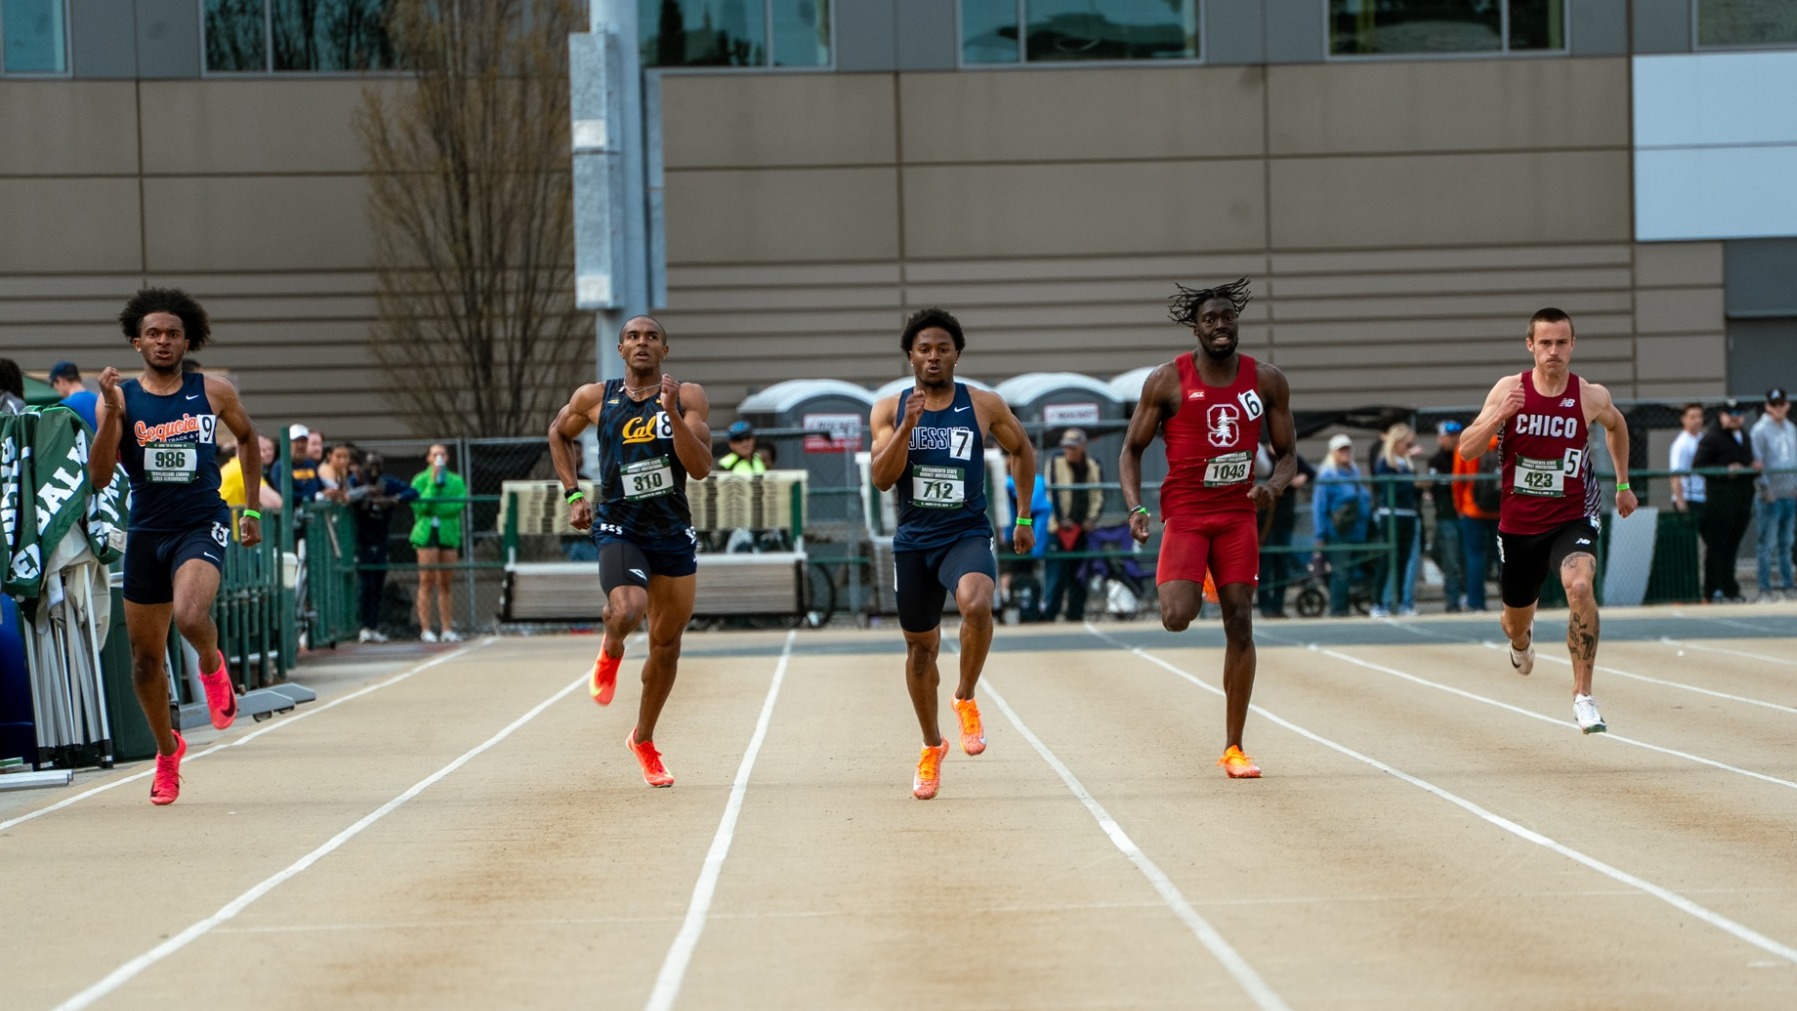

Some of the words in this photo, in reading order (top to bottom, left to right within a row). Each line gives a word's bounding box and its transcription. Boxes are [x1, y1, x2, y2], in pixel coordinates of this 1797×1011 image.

[1244, 392, 1260, 416] 6
[202, 416, 212, 441] 9
[622, 417, 656, 444] Cal
[661, 414, 673, 437] 8
[1515, 413, 1578, 438] CHICO
[908, 426, 969, 450] JESS
[956, 432, 969, 457] 7
[155, 451, 185, 468] 986
[1213, 464, 1246, 479] 1043
[1565, 450, 1579, 475] 5
[633, 472, 662, 491] 310
[923, 481, 953, 500] 712
[1524, 471, 1553, 488] 423
